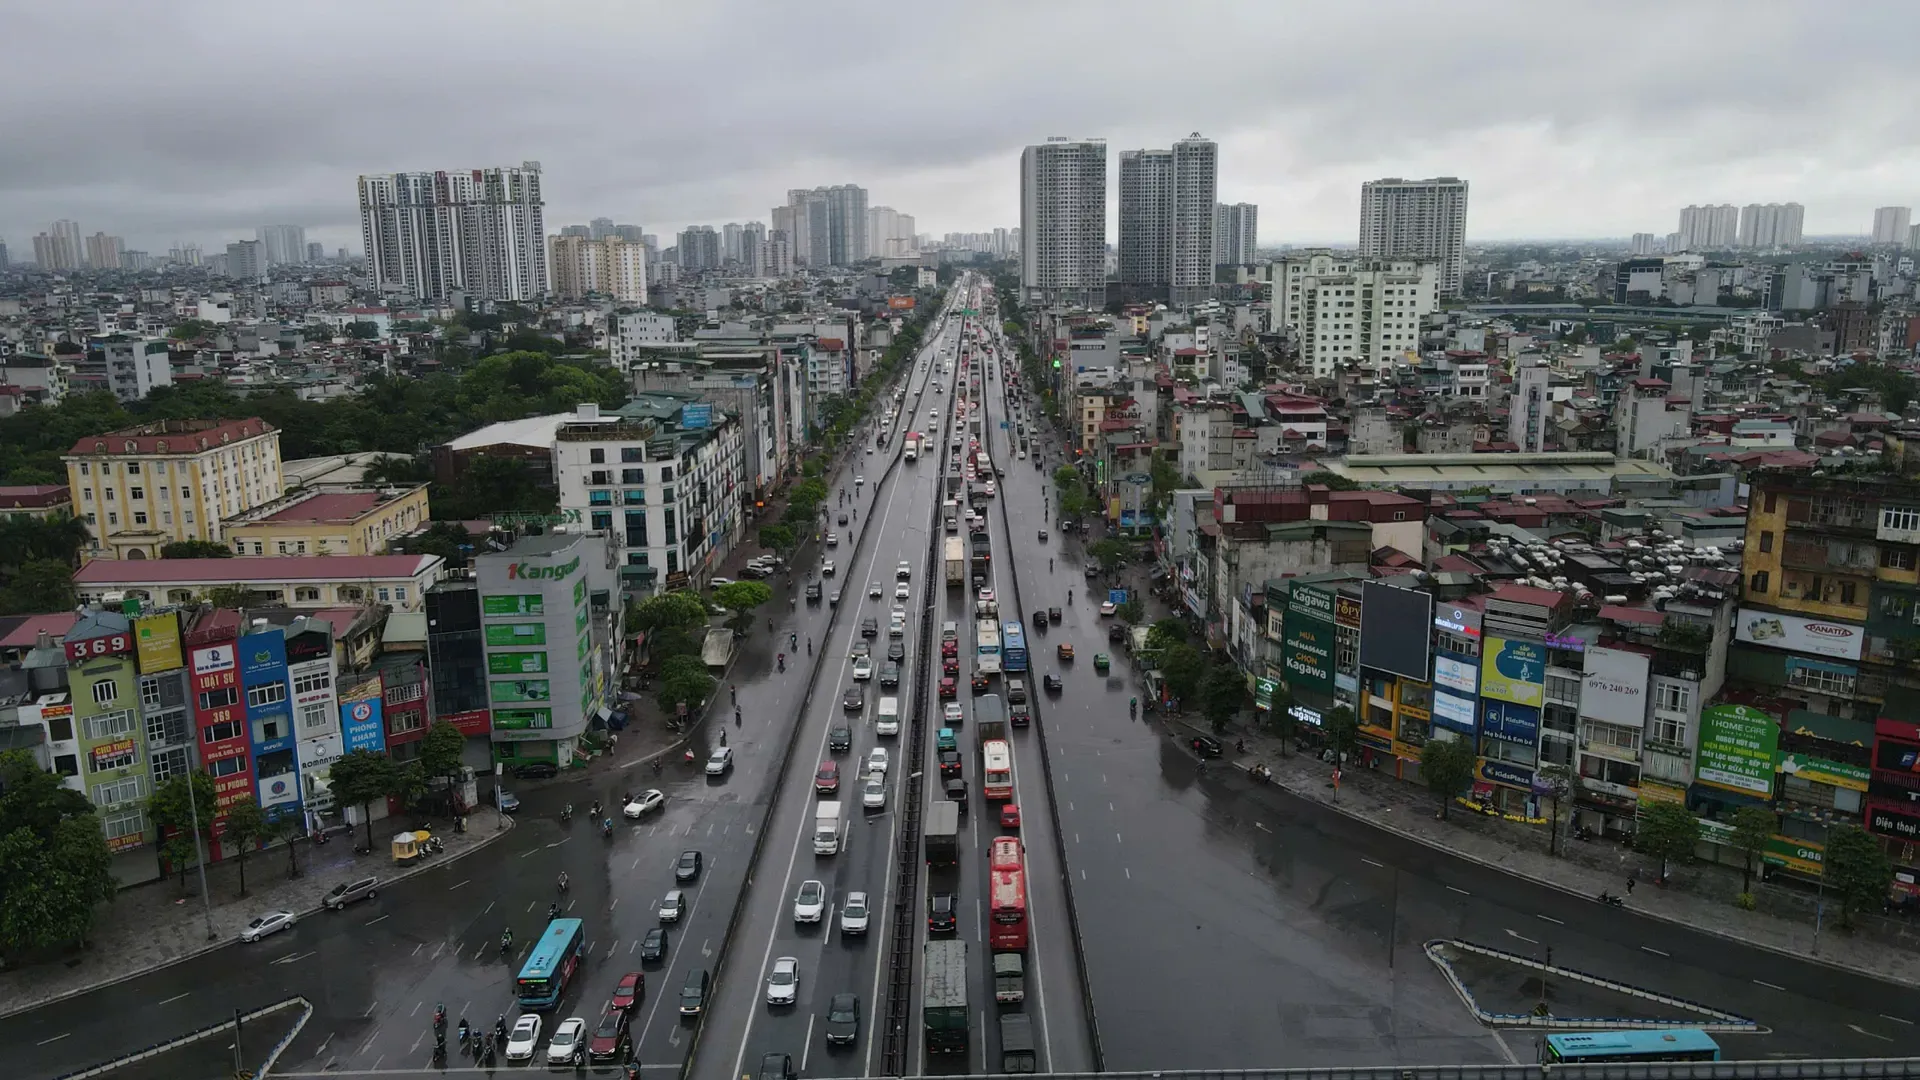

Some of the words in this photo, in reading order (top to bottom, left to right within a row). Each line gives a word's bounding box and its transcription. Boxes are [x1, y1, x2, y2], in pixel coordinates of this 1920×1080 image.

[1292, 588, 1331, 610] Kagawa
[1299, 631, 1316, 641] MUA
[1810, 625, 1848, 636] PANATTA
[74, 636, 125, 657] 369
[1299, 642, 1328, 657] MASSAGE
[1286, 656, 1327, 680] Kagawa
[200, 674, 219, 689] LUẬT
[223, 672, 234, 685] SƯ
[1589, 680, 1607, 690] 0976
[1609, 683, 1623, 692] 240
[1624, 686, 1639, 695] 269
[213, 709, 231, 723] 369
[1288, 707, 1321, 726] Kagawa
[1505, 716, 1536, 728] KidsPlaza
[1715, 720, 1744, 731] HOME
[1744, 725, 1767, 736] CARE
[371, 740, 377, 748] Y
[1716, 735, 1735, 744] ROBOT
[95, 744, 112, 756] CHO
[113, 739, 133, 751] THUÊ
[1701, 749, 1715, 758] MÁY
[301, 754, 341, 769] ROMANTIC
[1709, 760, 1727, 770] MÁY
[1744, 766, 1760, 777] BÁT
[227, 778, 248, 791] PHÒNG
[1495, 770, 1530, 784] KidsPlaza
[1875, 815, 1893, 829] Điện
[1896, 823, 1916, 837] thoại
[121, 832, 141, 845] THUÊ
[1797, 848, 1821, 861] F88
